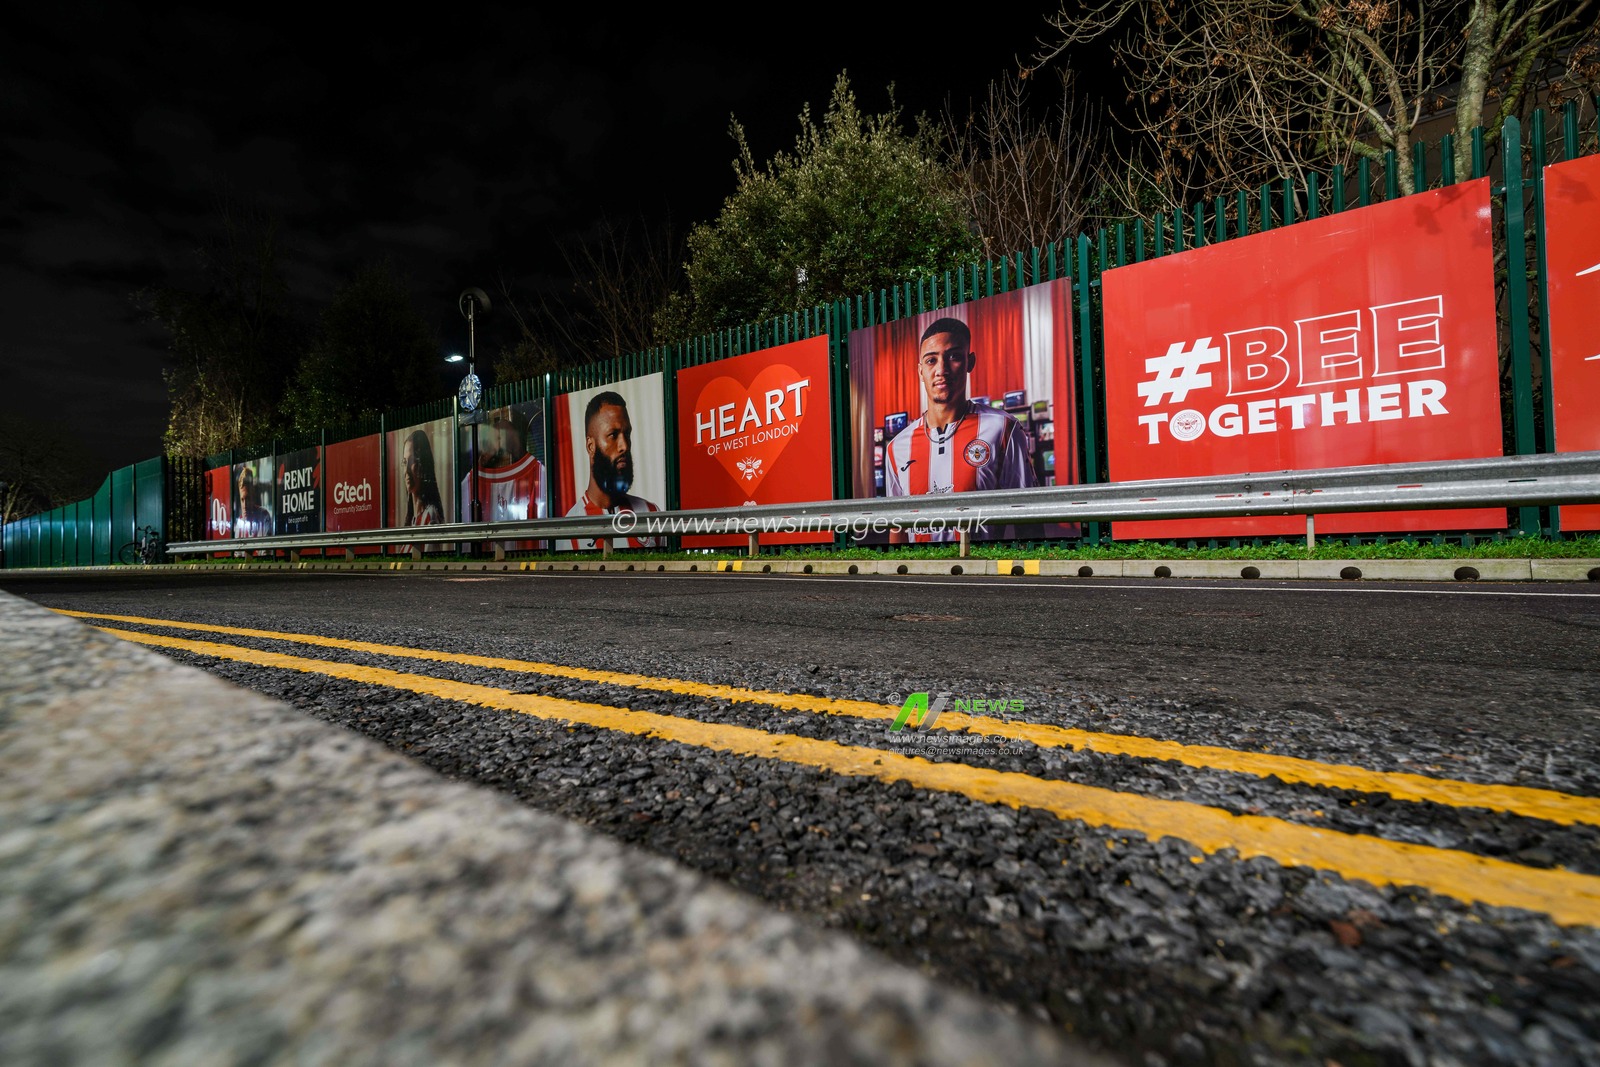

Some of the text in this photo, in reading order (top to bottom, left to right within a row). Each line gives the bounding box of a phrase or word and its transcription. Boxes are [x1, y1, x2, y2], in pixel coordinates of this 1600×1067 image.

[1137, 295, 1445, 407] #BEE
[695, 379, 810, 445] HEART
[1138, 379, 1449, 445] TOGETHER
[707, 422, 799, 456] OF WEST LONDON
[284, 467, 313, 491] RENT
[333, 478, 372, 505] Gtech
[282, 490, 315, 514] HOME
[333, 503, 372, 515] Community Stadium
